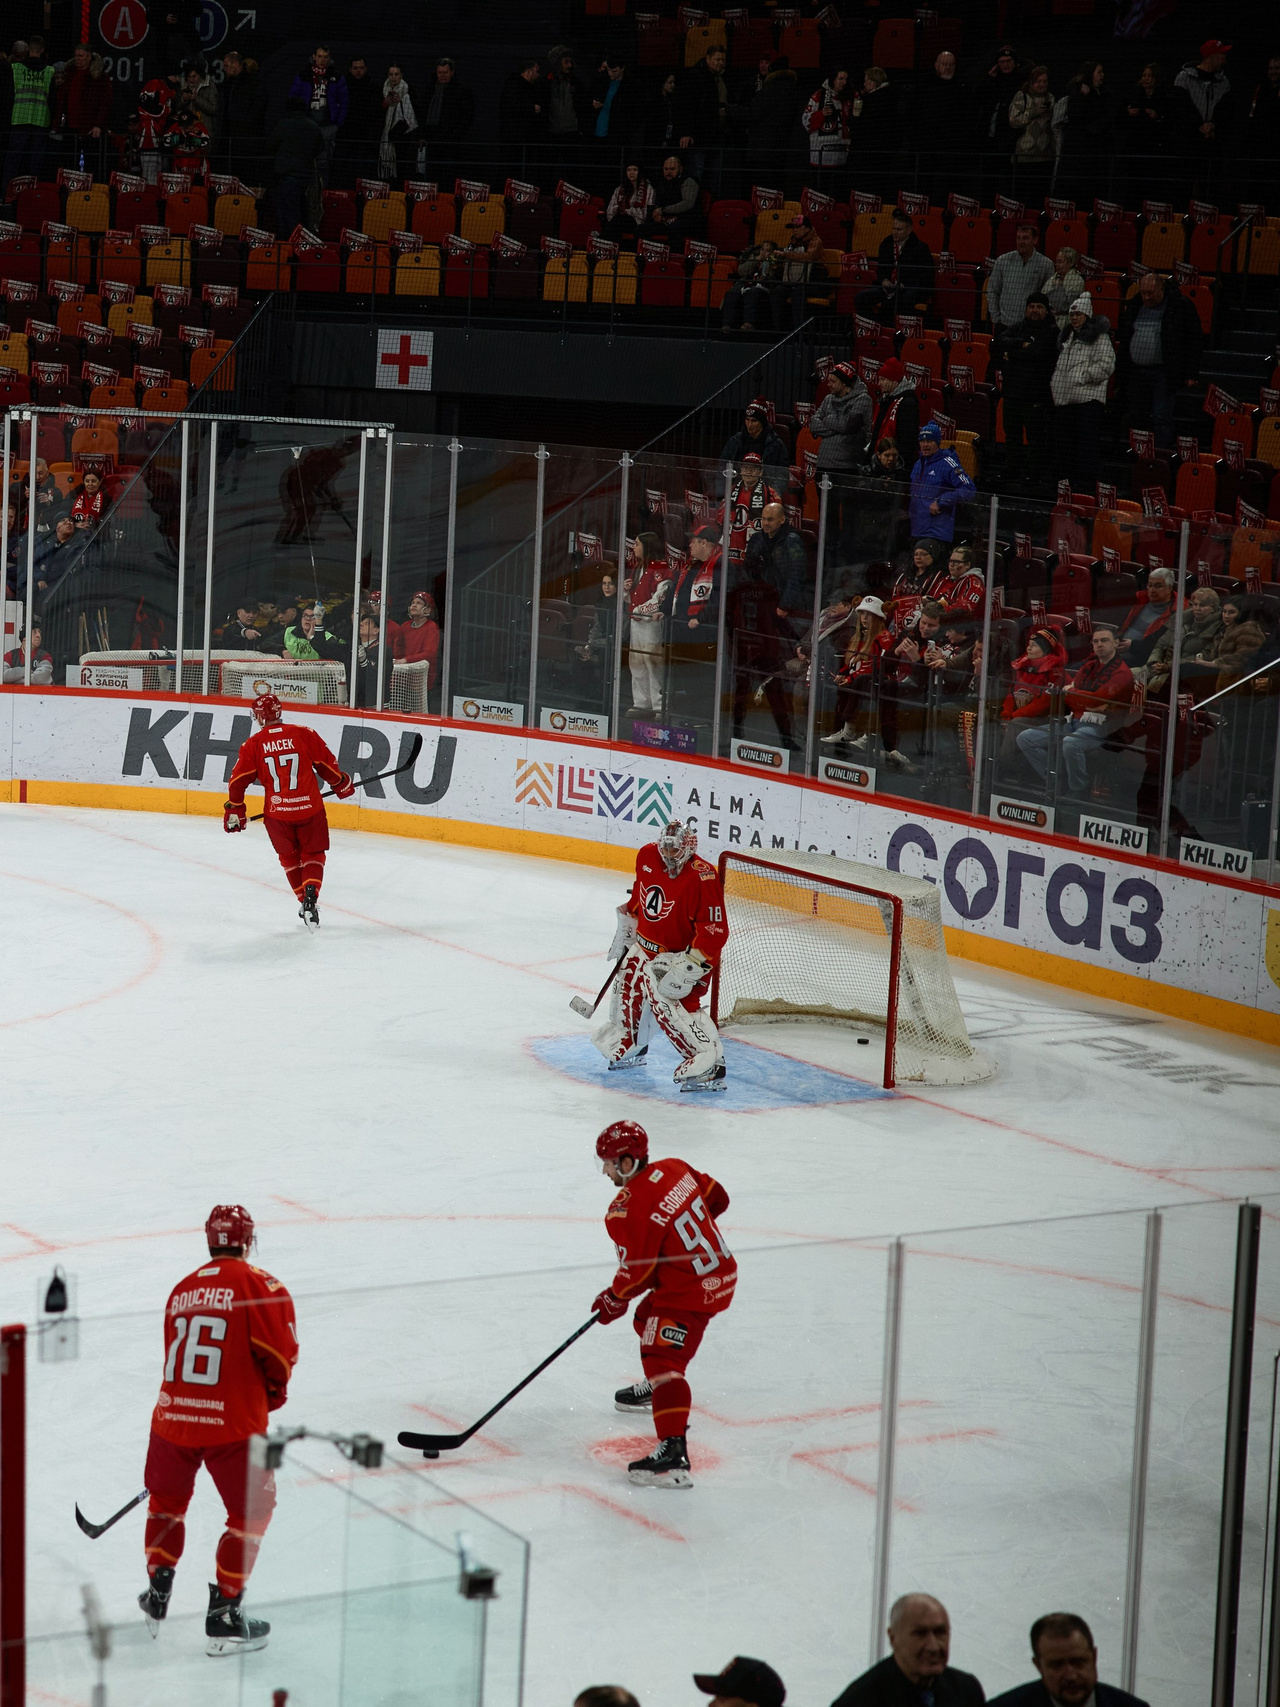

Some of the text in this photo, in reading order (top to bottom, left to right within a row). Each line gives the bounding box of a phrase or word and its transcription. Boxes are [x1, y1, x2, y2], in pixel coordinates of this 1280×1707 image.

[113, 6, 135, 41] A
[95, 679, 129, 690] ЗАВОД
[273, 683, 307, 693] УГМК
[481, 704, 514, 716] УГМК
[481, 711, 514, 722] UMMC
[568, 716, 599, 728] УГМК
[568, 723, 599, 734] UMMC
[262, 738, 295, 754] MACEK
[740, 746, 773, 764] WINLINE
[122, 706, 458, 805] KHRU
[264, 752, 300, 793] 17
[827, 765, 860, 783] WINLINE
[1000, 804, 1037, 823] WINLINE
[1083, 820, 1144, 849] KHL.RU
[1183, 843, 1249, 874] KHL.RU
[708, 905, 723, 923] 18
[217, 1232, 228, 1246] 16
[171, 1287, 235, 1317] BOUCHER
[663, 1329, 685, 1343] WIN
[165, 1314, 228, 1387] 16
[173, 1396, 225, 1412] УРАЛМАШЗАВОД
